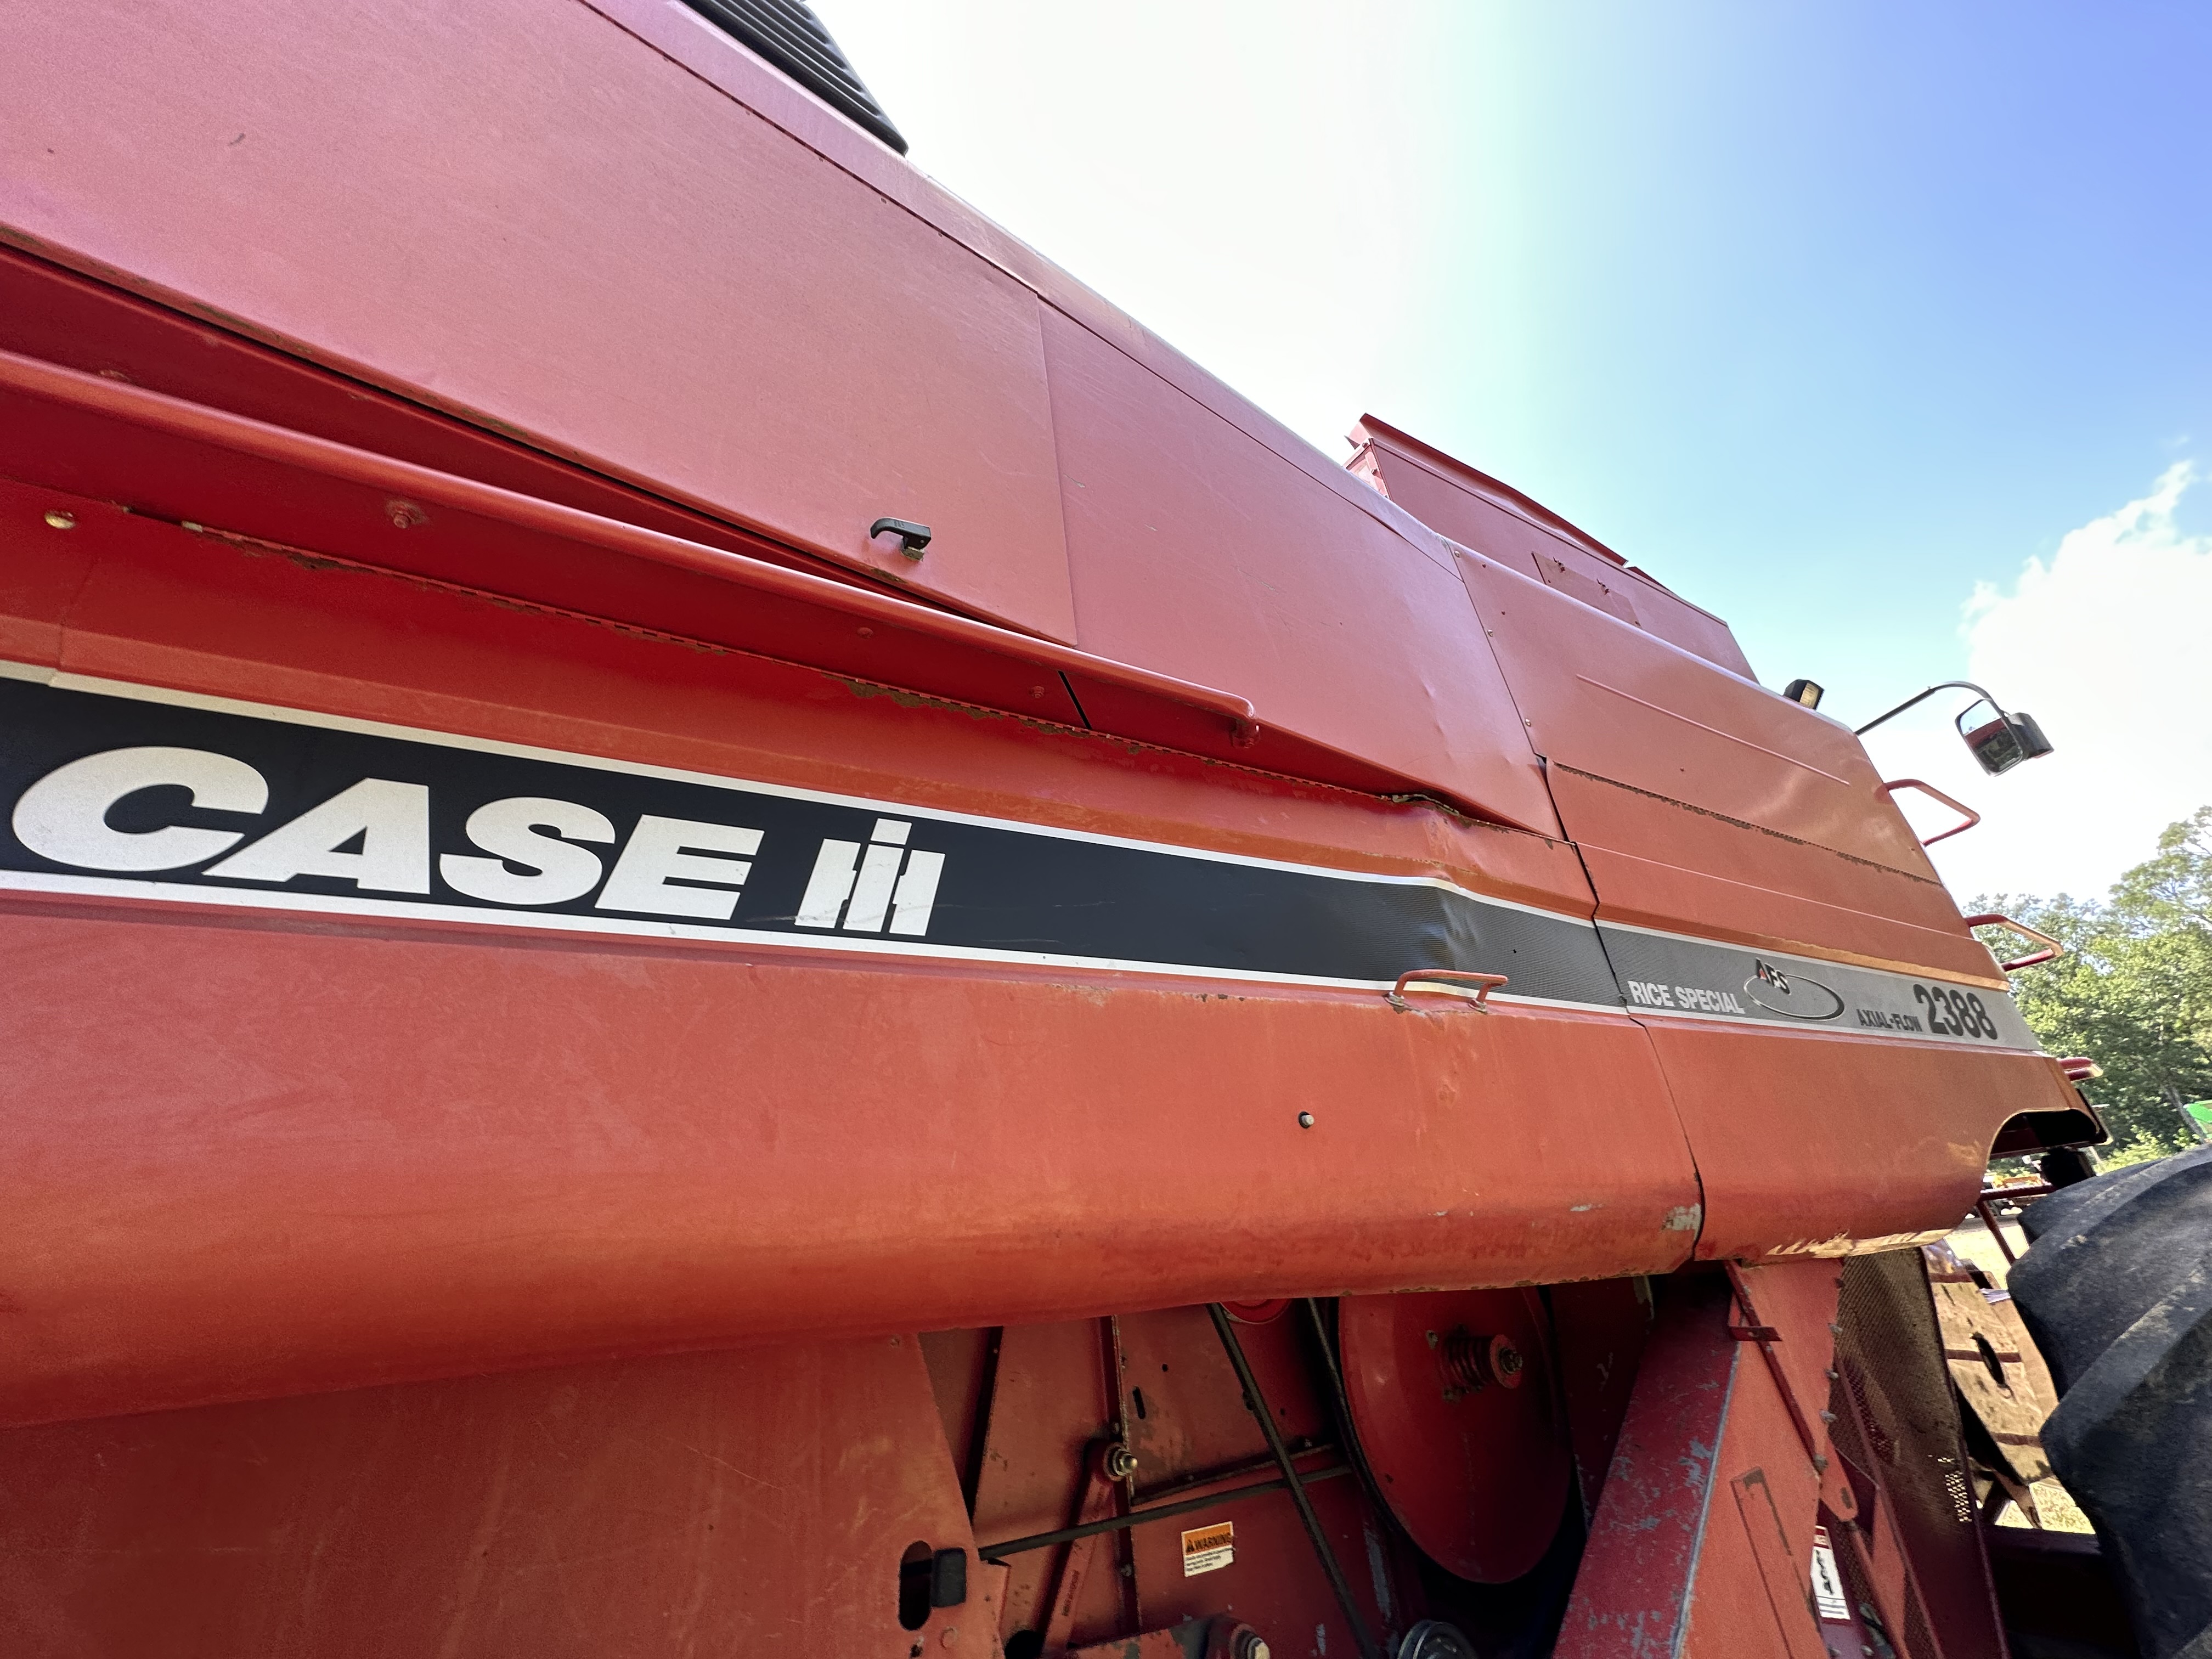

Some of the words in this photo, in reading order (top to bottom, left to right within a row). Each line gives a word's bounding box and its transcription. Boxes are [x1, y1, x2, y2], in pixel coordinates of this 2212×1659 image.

[11, 745, 765, 922] CASE
[1627, 980, 1675, 1007] RICE
[1675, 986, 1746, 1014] SPECIAL
[1756, 958, 1791, 995] AFS
[1857, 1008, 1922, 1032] AXIAL-FLOW
[1912, 984, 1998, 1040] 2388
